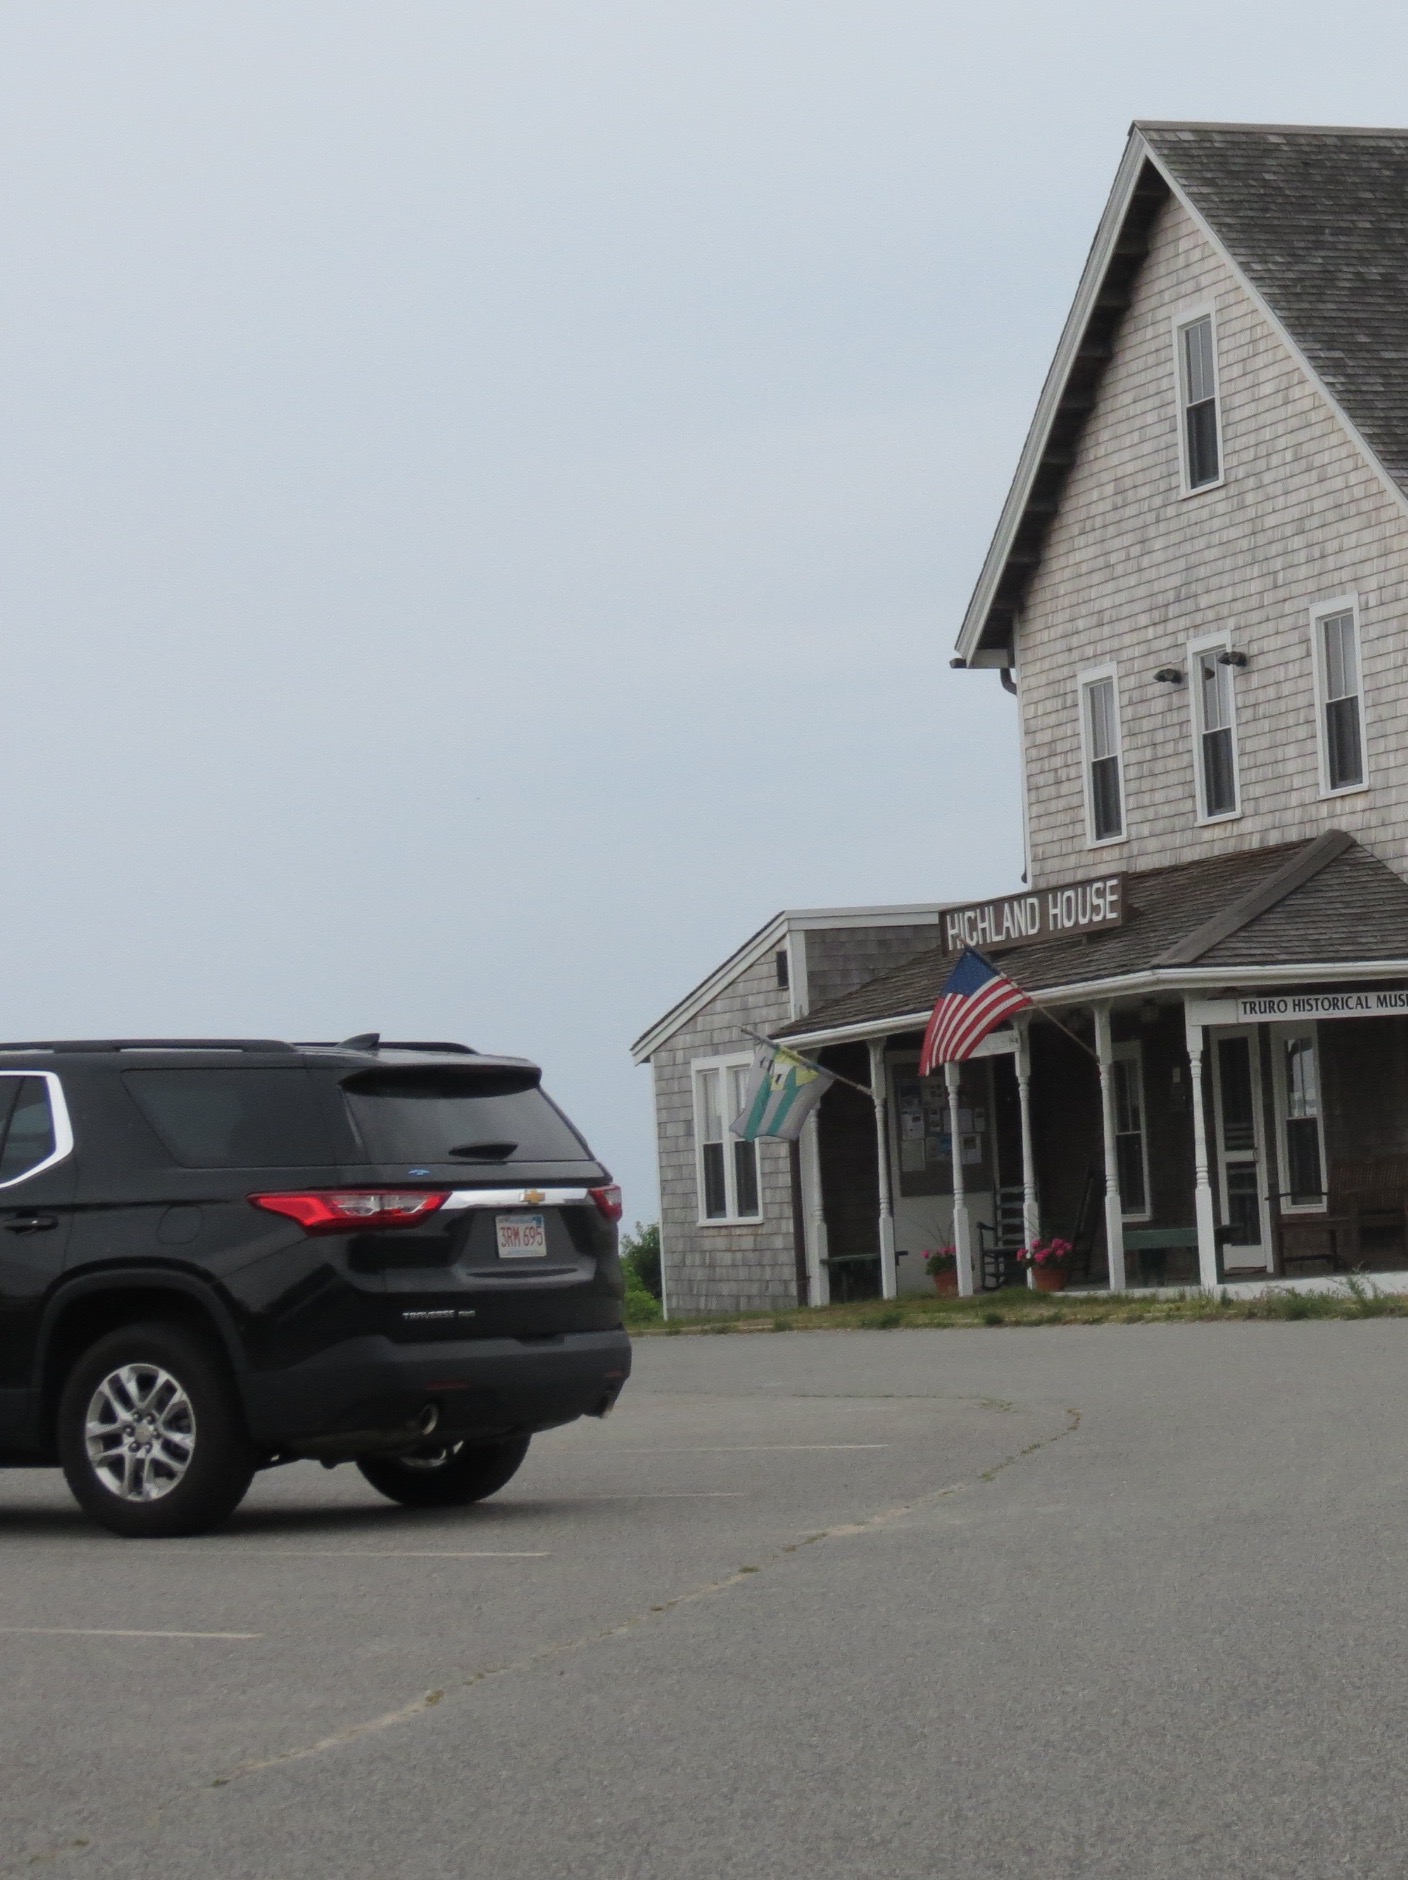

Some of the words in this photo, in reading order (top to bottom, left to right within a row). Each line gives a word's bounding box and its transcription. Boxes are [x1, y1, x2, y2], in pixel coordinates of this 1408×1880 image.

[1048, 879, 1119, 931] HOUSE
[1241, 999, 1288, 1015] TRURO
[1292, 995, 1372, 1013] HISTORICAL
